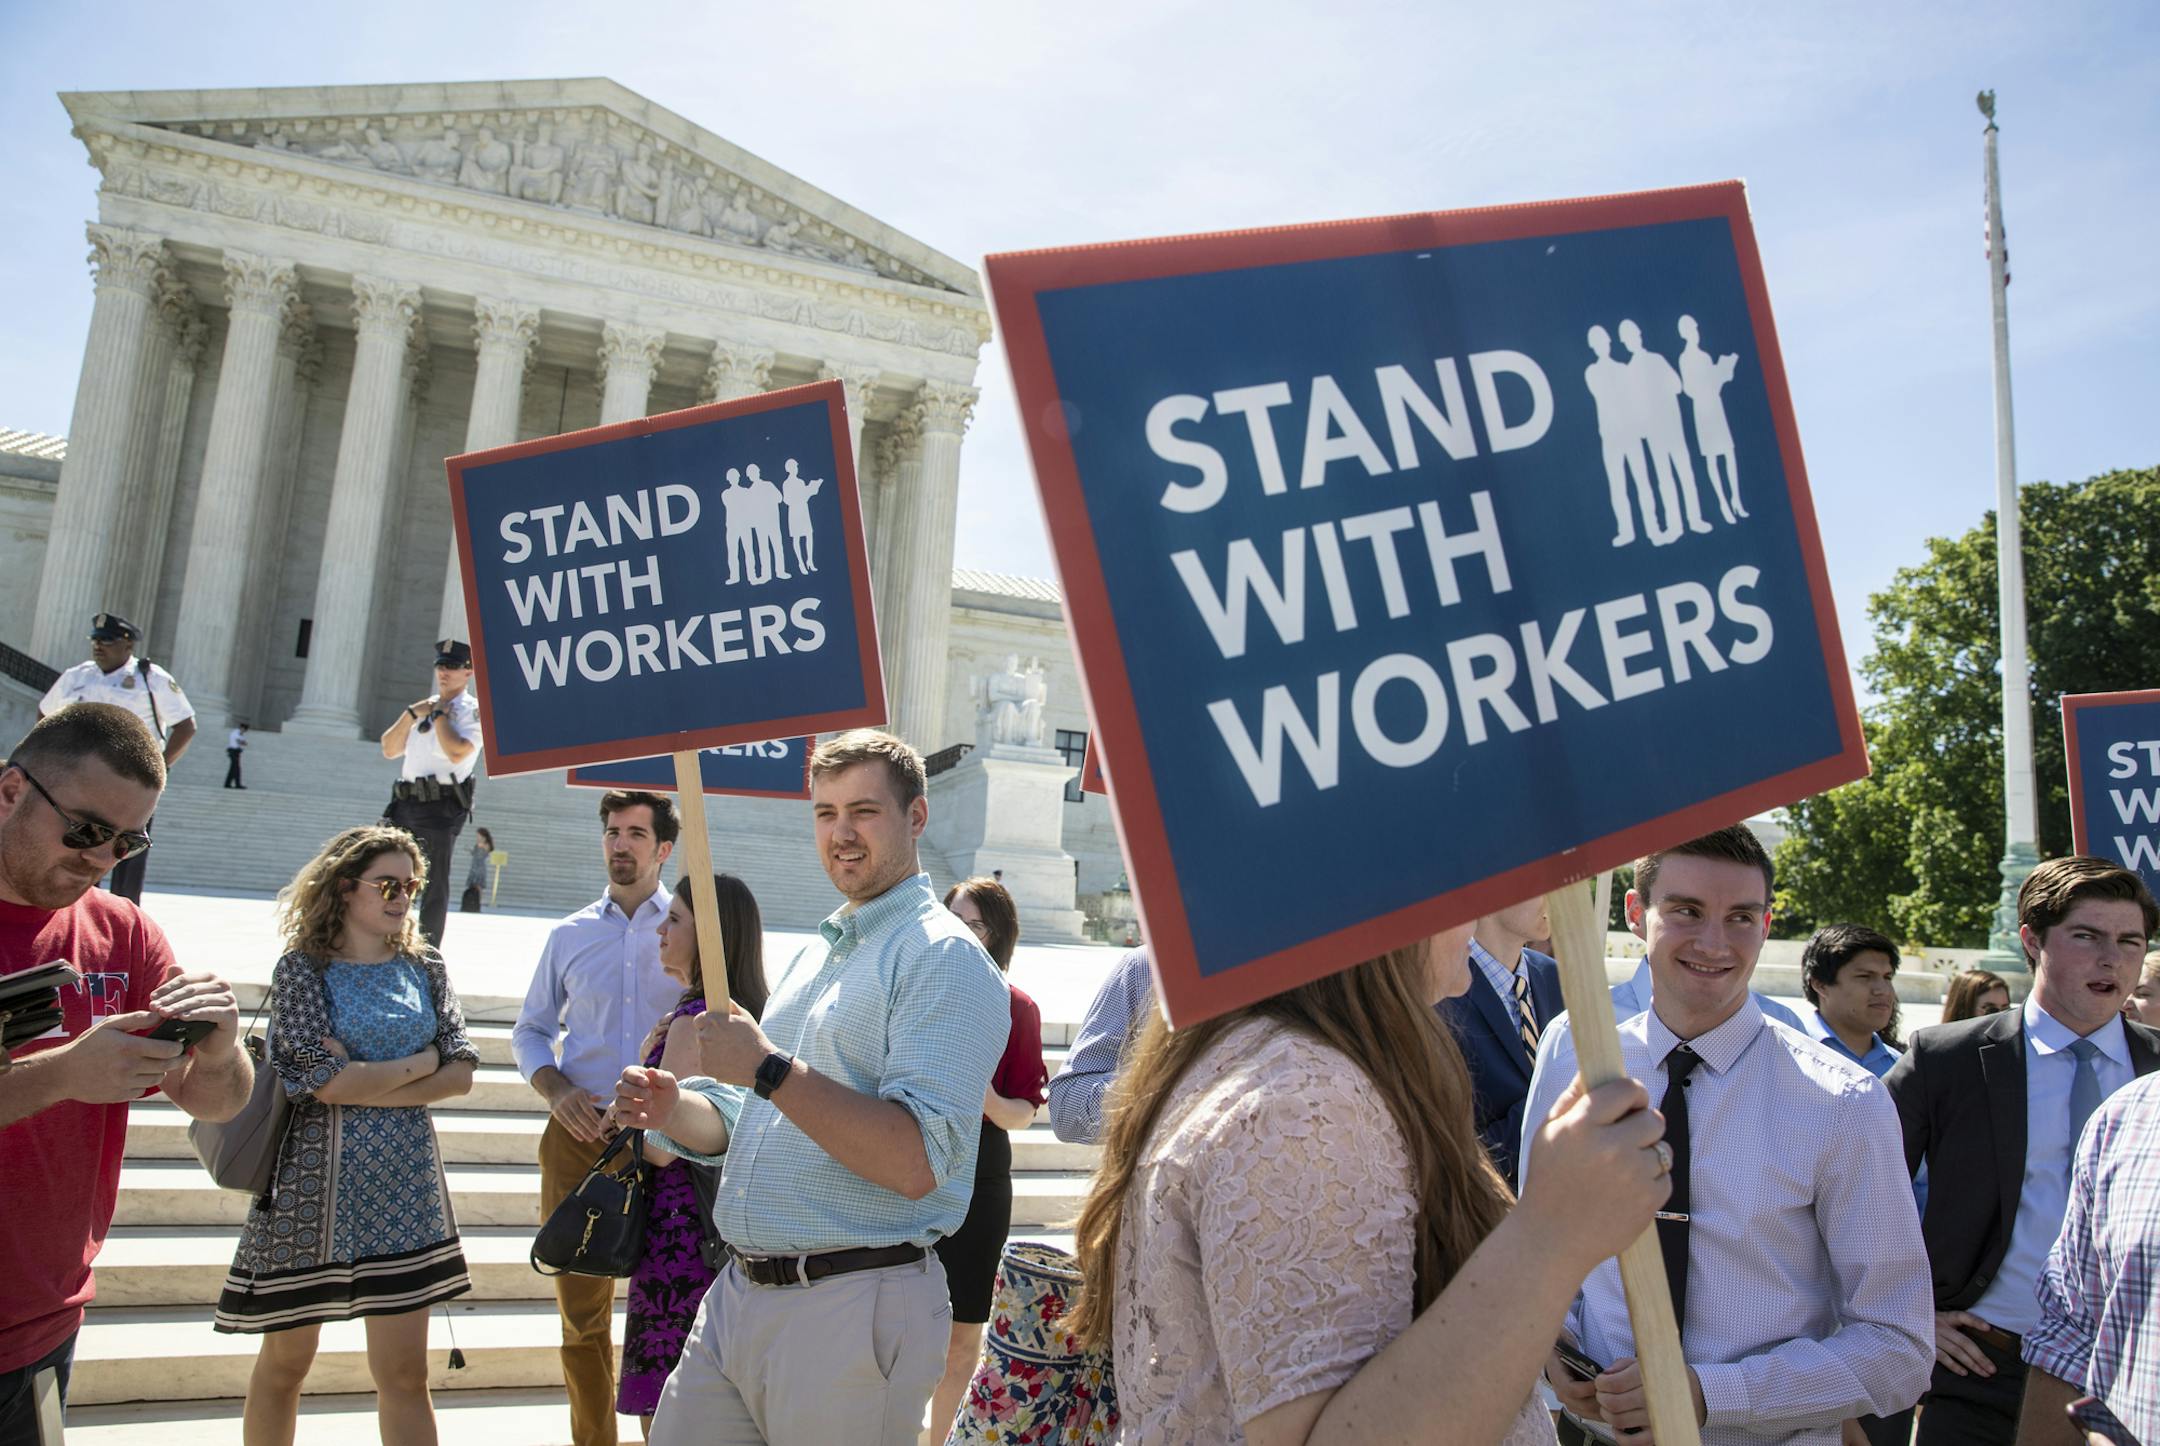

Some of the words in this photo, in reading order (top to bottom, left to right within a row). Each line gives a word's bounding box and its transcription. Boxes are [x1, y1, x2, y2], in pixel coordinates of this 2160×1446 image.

[606, 268, 683, 298] UNDER
[692, 283, 737, 307] LAW
[1145, 349, 1555, 514] STAND
[499, 484, 701, 564] STAND
[504, 554, 663, 627] WITH
[1170, 490, 1513, 659] WITH
[512, 597, 826, 691] WORKERS
[1206, 565, 1774, 808] WORKERS
